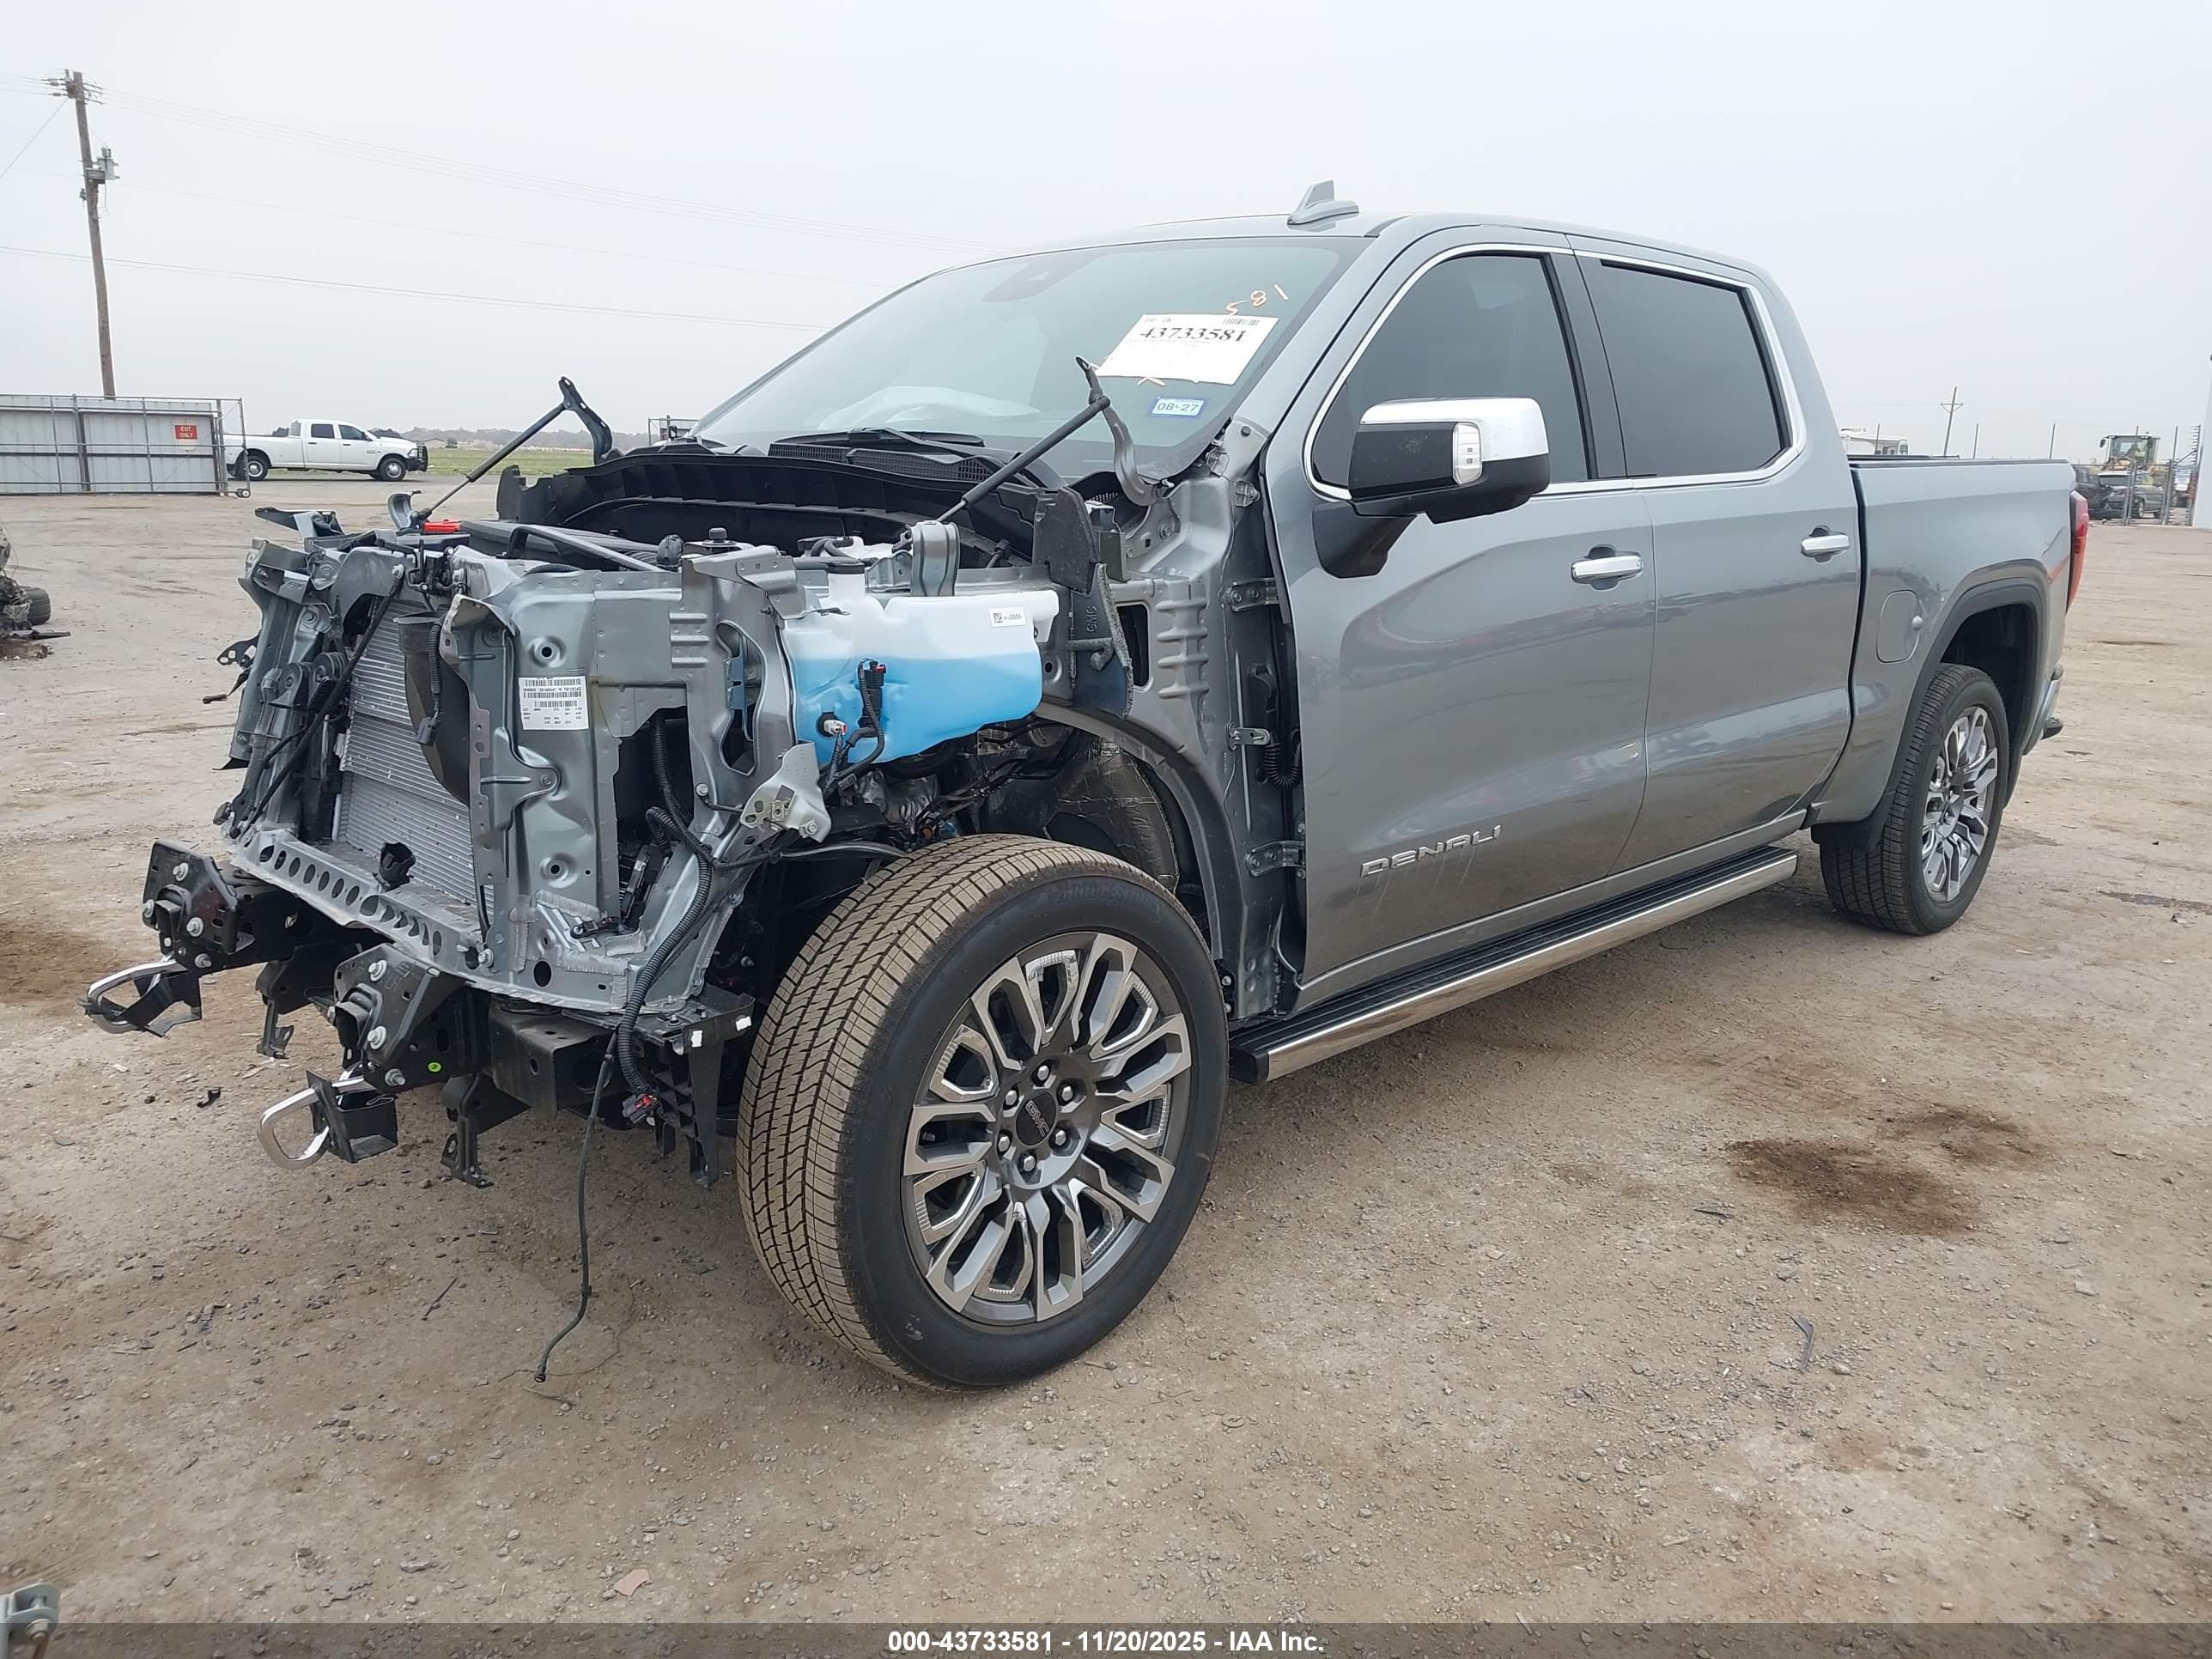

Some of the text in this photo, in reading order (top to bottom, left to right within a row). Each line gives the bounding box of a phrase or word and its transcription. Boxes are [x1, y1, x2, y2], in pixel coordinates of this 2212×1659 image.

[1139, 327, 1246, 342] 43733581
[1086, 605, 1097, 632] GMC
[1360, 824, 1501, 878] DENALI
[1025, 1100, 1049, 1137] GMC
